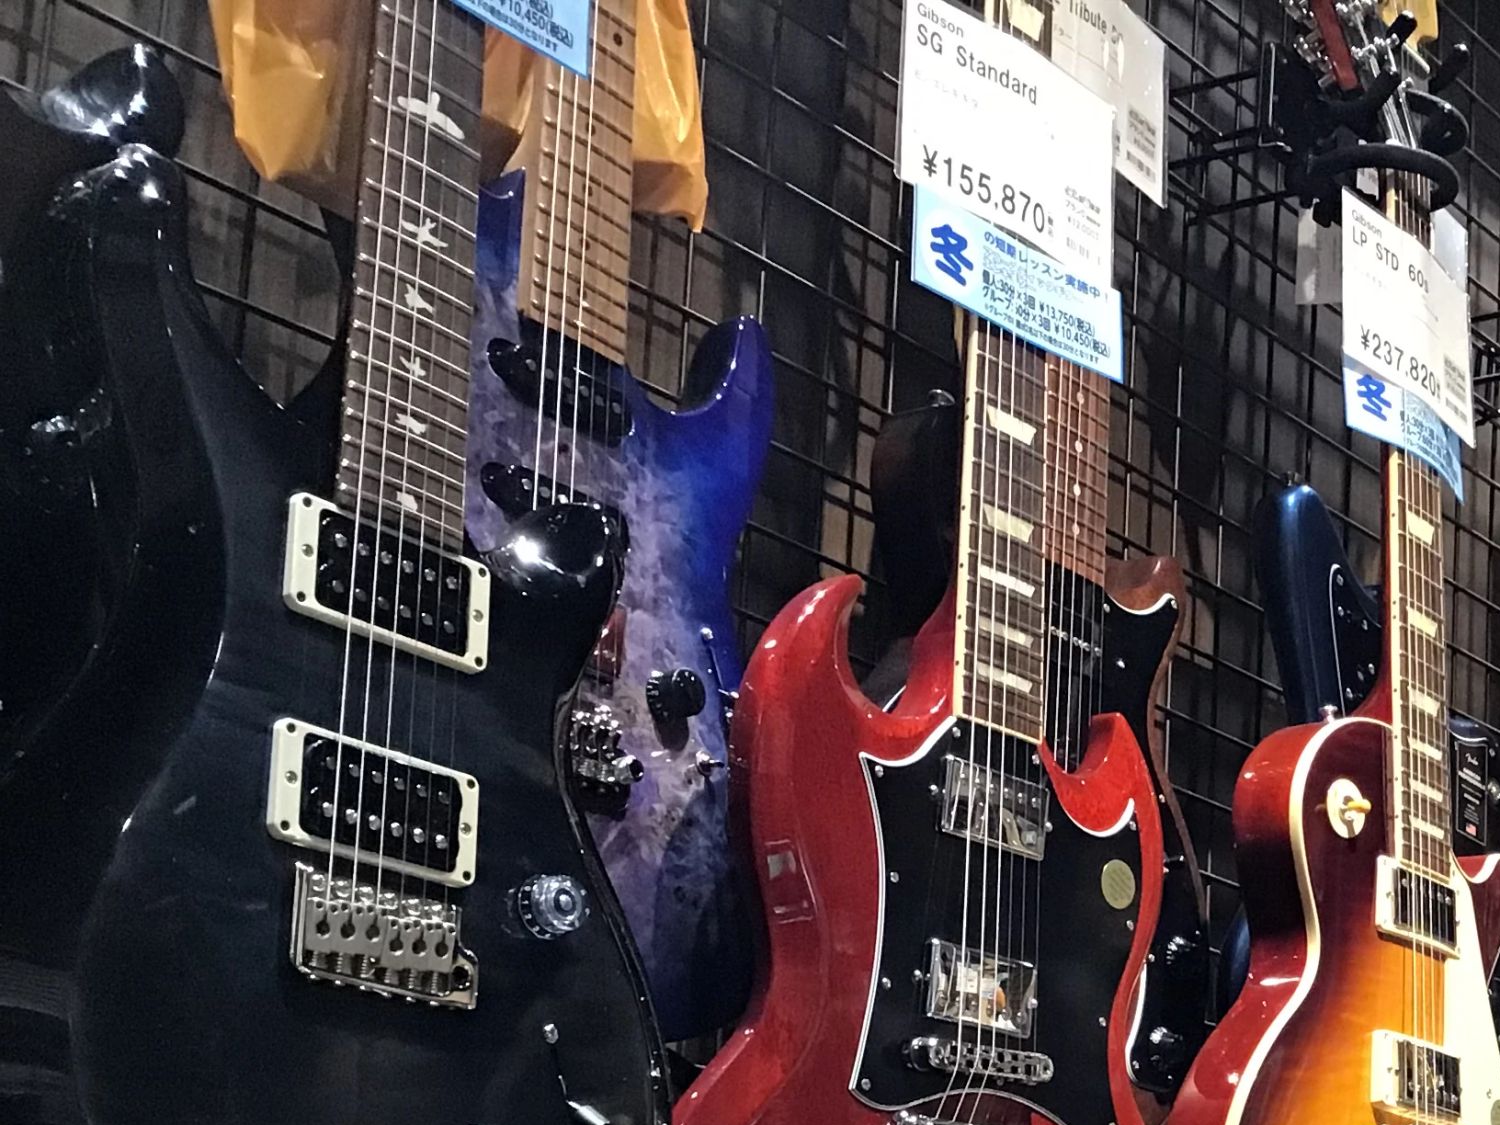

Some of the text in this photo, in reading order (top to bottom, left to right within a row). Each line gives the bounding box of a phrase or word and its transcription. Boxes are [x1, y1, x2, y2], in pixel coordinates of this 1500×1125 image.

[917, 2, 964, 38] Gibson
[917, 23, 943, 55] SG
[956, 45, 1037, 106] Standard
[922, 144, 1046, 236] ¥155,870
[1351, 209, 1383, 240] Gibson
[1352, 225, 1368, 247] LP
[1375, 242, 1400, 271] STD
[930, 223, 974, 287] 冬
[1356, 373, 1393, 422] 冬
